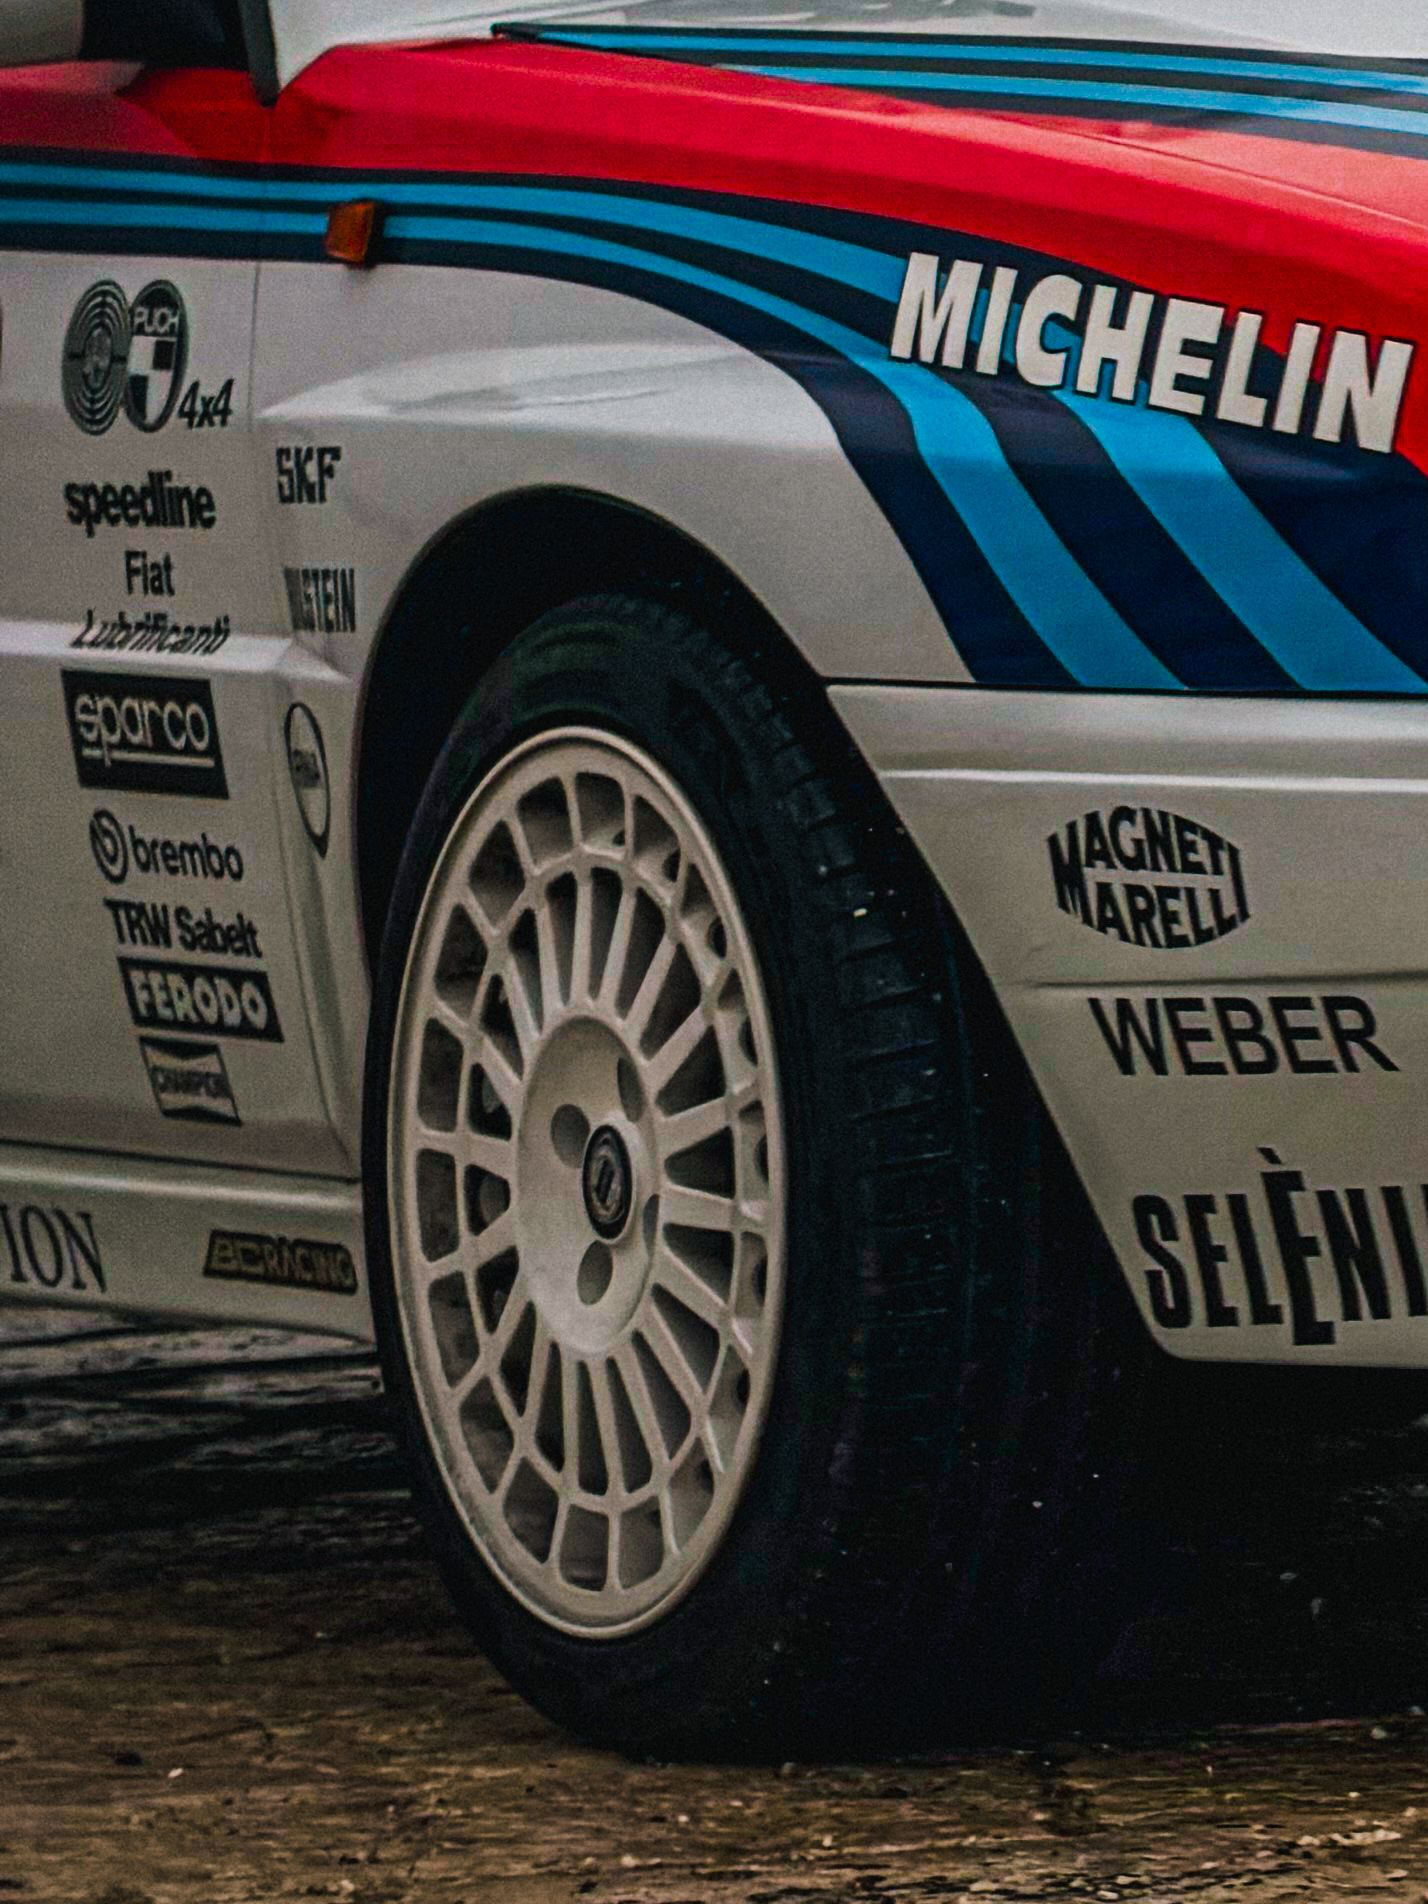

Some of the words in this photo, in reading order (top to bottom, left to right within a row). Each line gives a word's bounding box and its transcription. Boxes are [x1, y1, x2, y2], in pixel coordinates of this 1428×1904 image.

[133, 306, 181, 336] PUCH
[891, 251, 1413, 453] MICHELIN
[177, 377, 235, 430] 4x4
[63, 470, 216, 538] speedline
[276, 446, 341, 504] SKF
[125, 550, 175, 597] Fiat
[70, 609, 231, 656] Lubrificanti
[74, 693, 210, 767] sparco
[129, 826, 243, 882] brembo
[1047, 805, 1243, 886] MAGNETI
[103, 898, 171, 949] TRW
[174, 906, 263, 958] Sabelt
[1057, 870, 1251, 949] MARELLI
[128, 969, 268, 1030] FERODO
[1088, 995, 1401, 1076] WEBER
